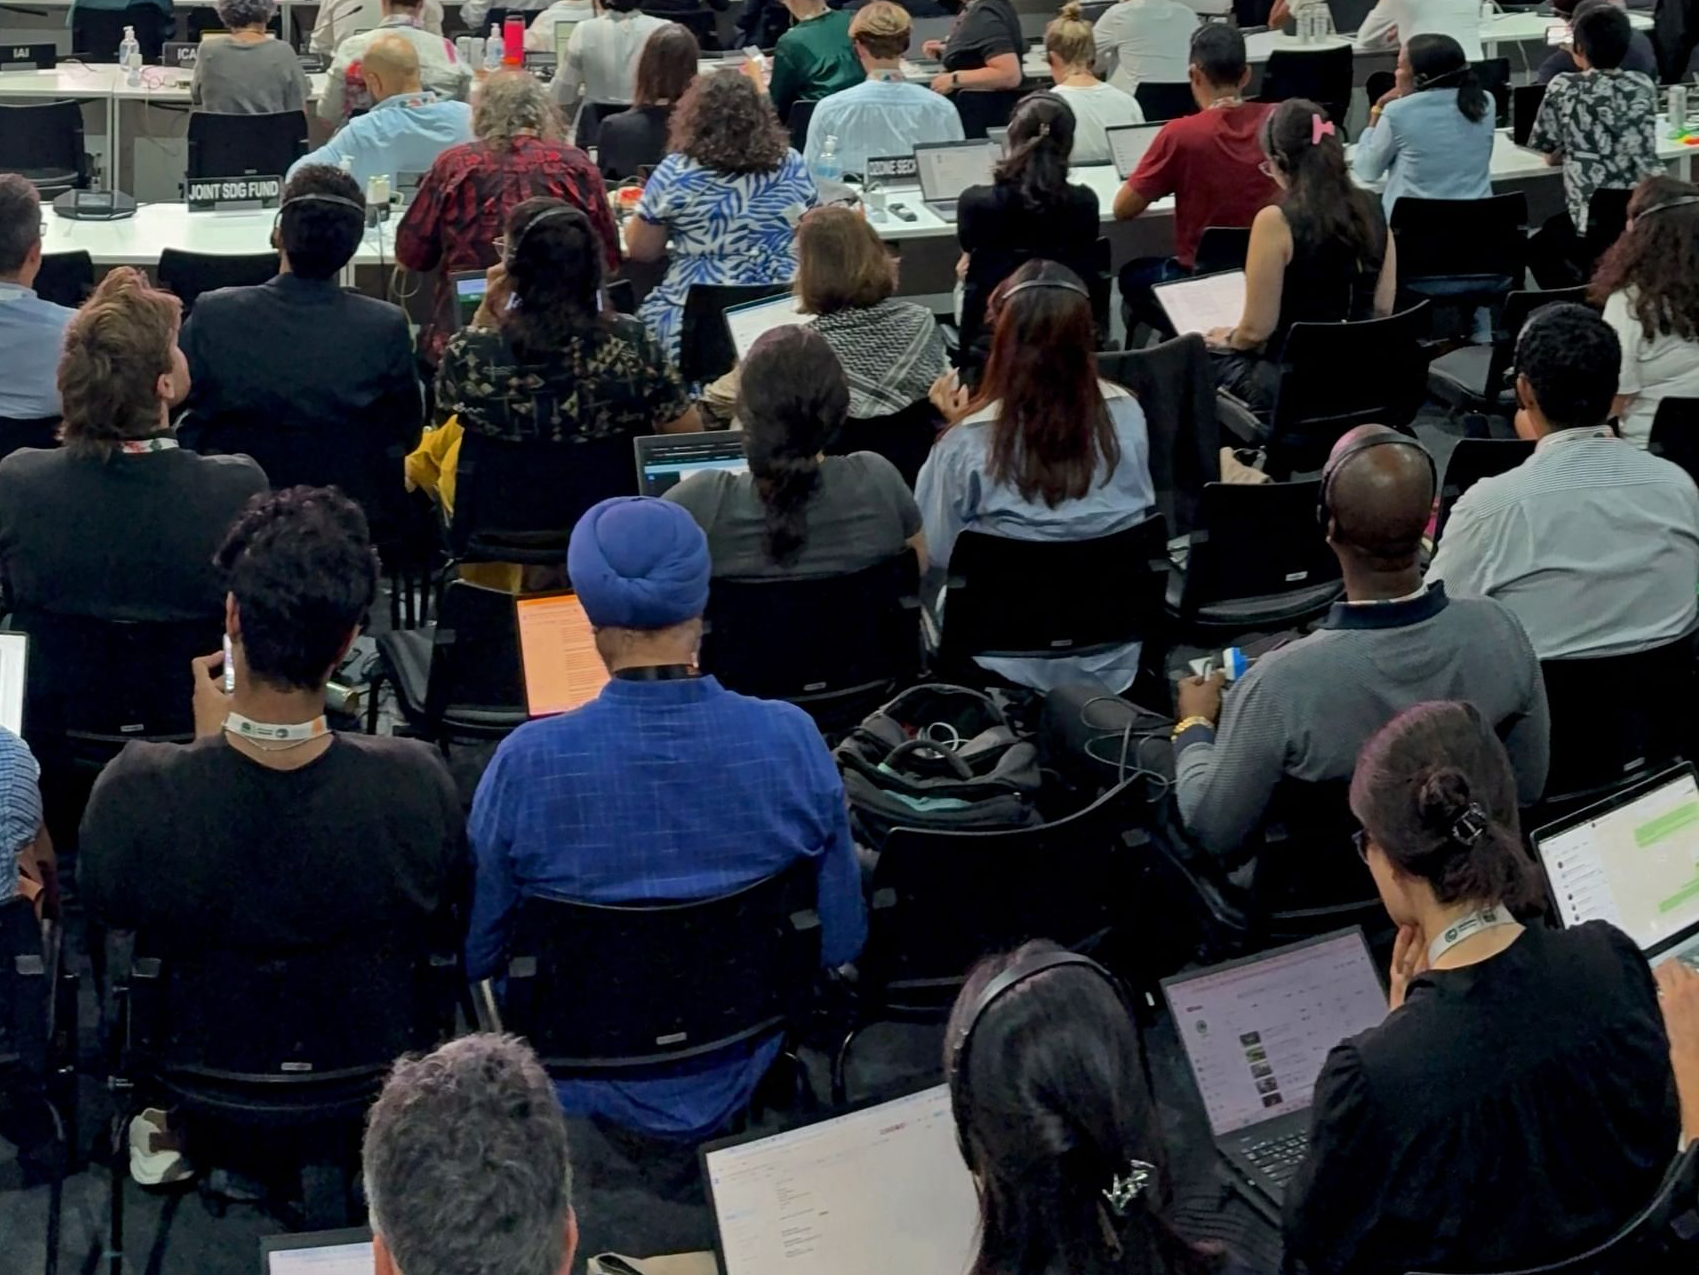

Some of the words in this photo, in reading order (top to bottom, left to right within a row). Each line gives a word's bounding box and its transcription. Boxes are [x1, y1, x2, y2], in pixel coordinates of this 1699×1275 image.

[13, 47, 30, 58] IAI
[188, 183, 221, 200] JOINT
[222, 182, 247, 199] SDG
[248, 180, 279, 197] FUND
